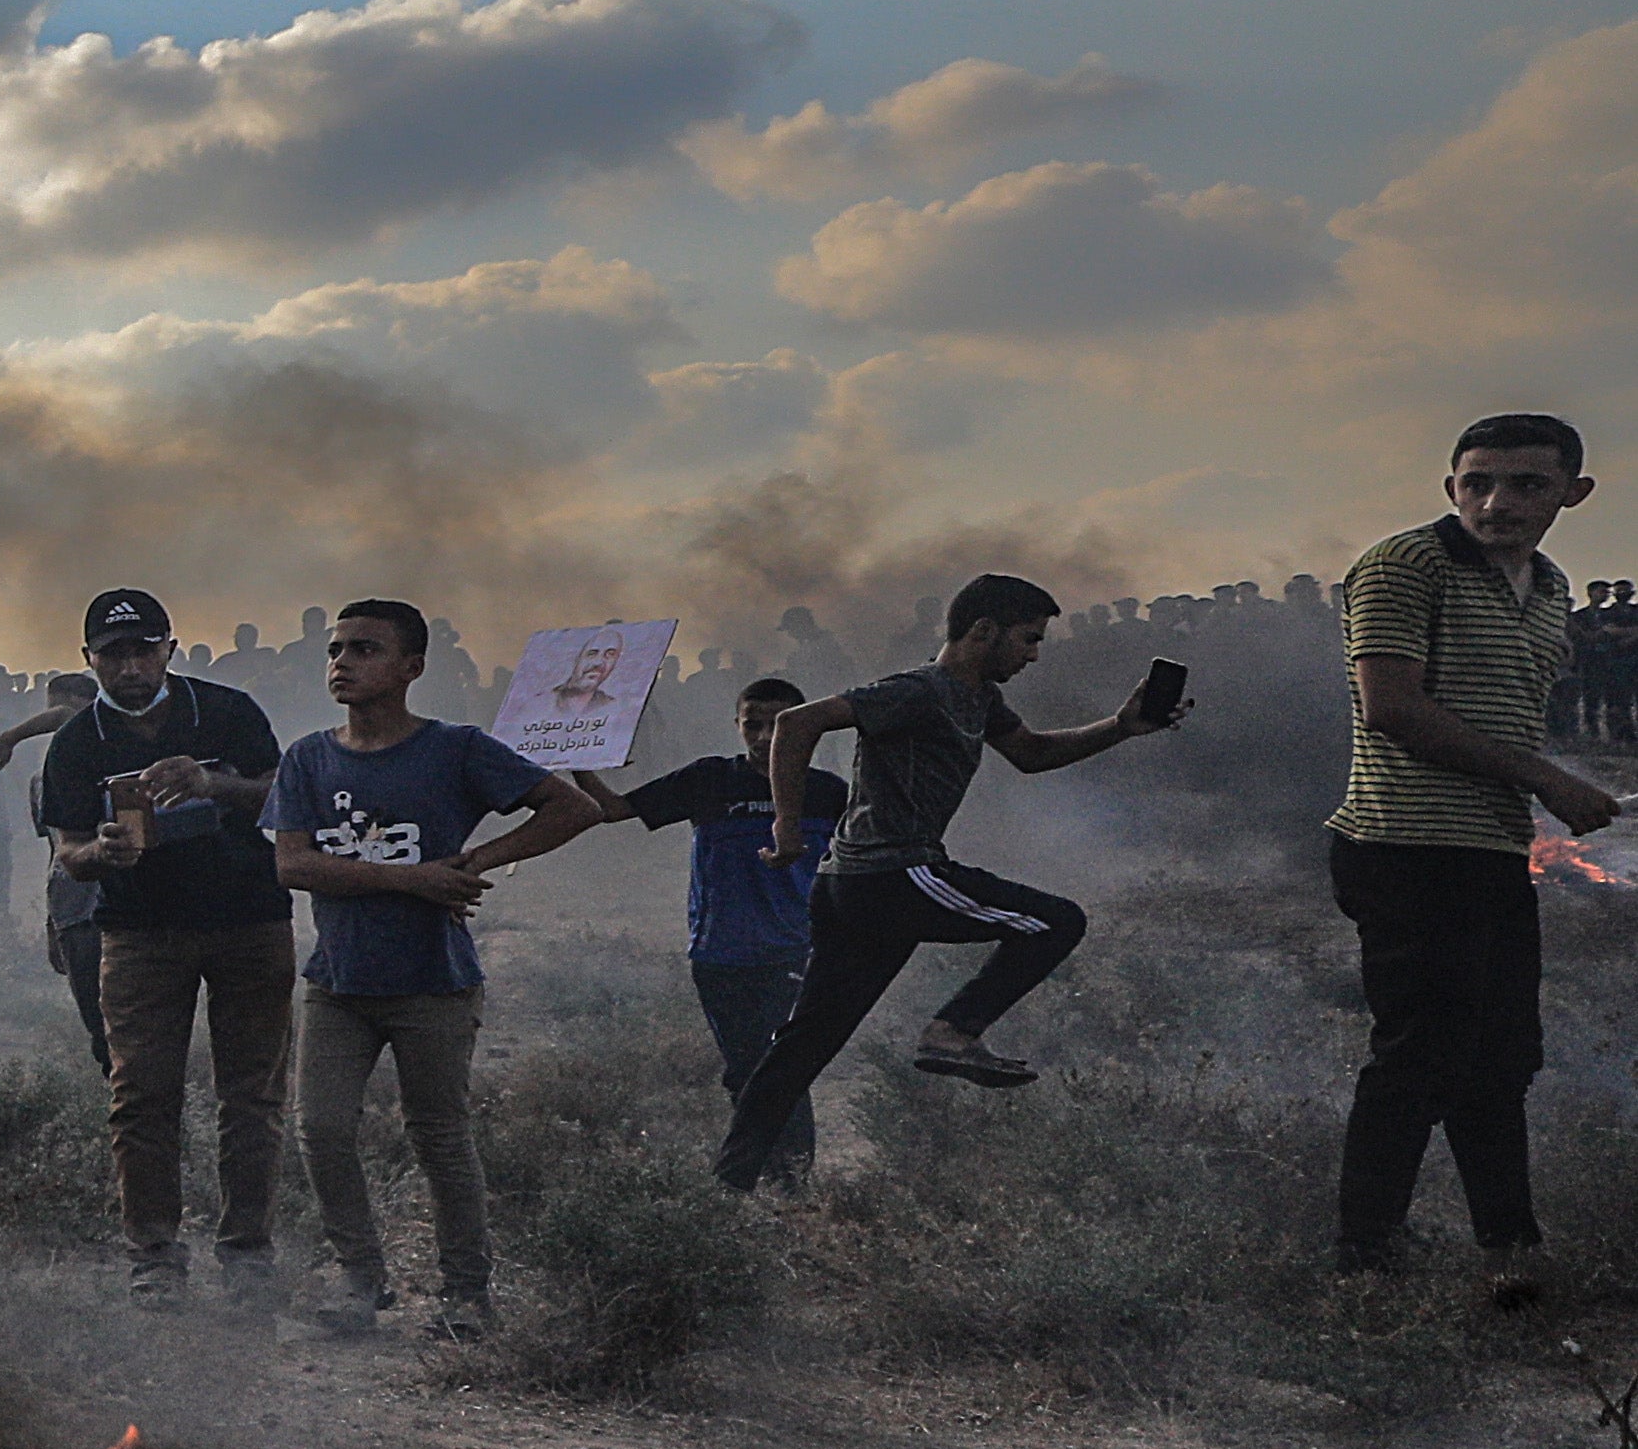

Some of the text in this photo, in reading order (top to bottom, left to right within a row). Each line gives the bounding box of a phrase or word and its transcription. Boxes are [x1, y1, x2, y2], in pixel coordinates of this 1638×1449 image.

[105, 614, 141, 623] adidas
[523, 714, 609, 736] لو رحل صوتي
[593, 735, 605, 747] ما
